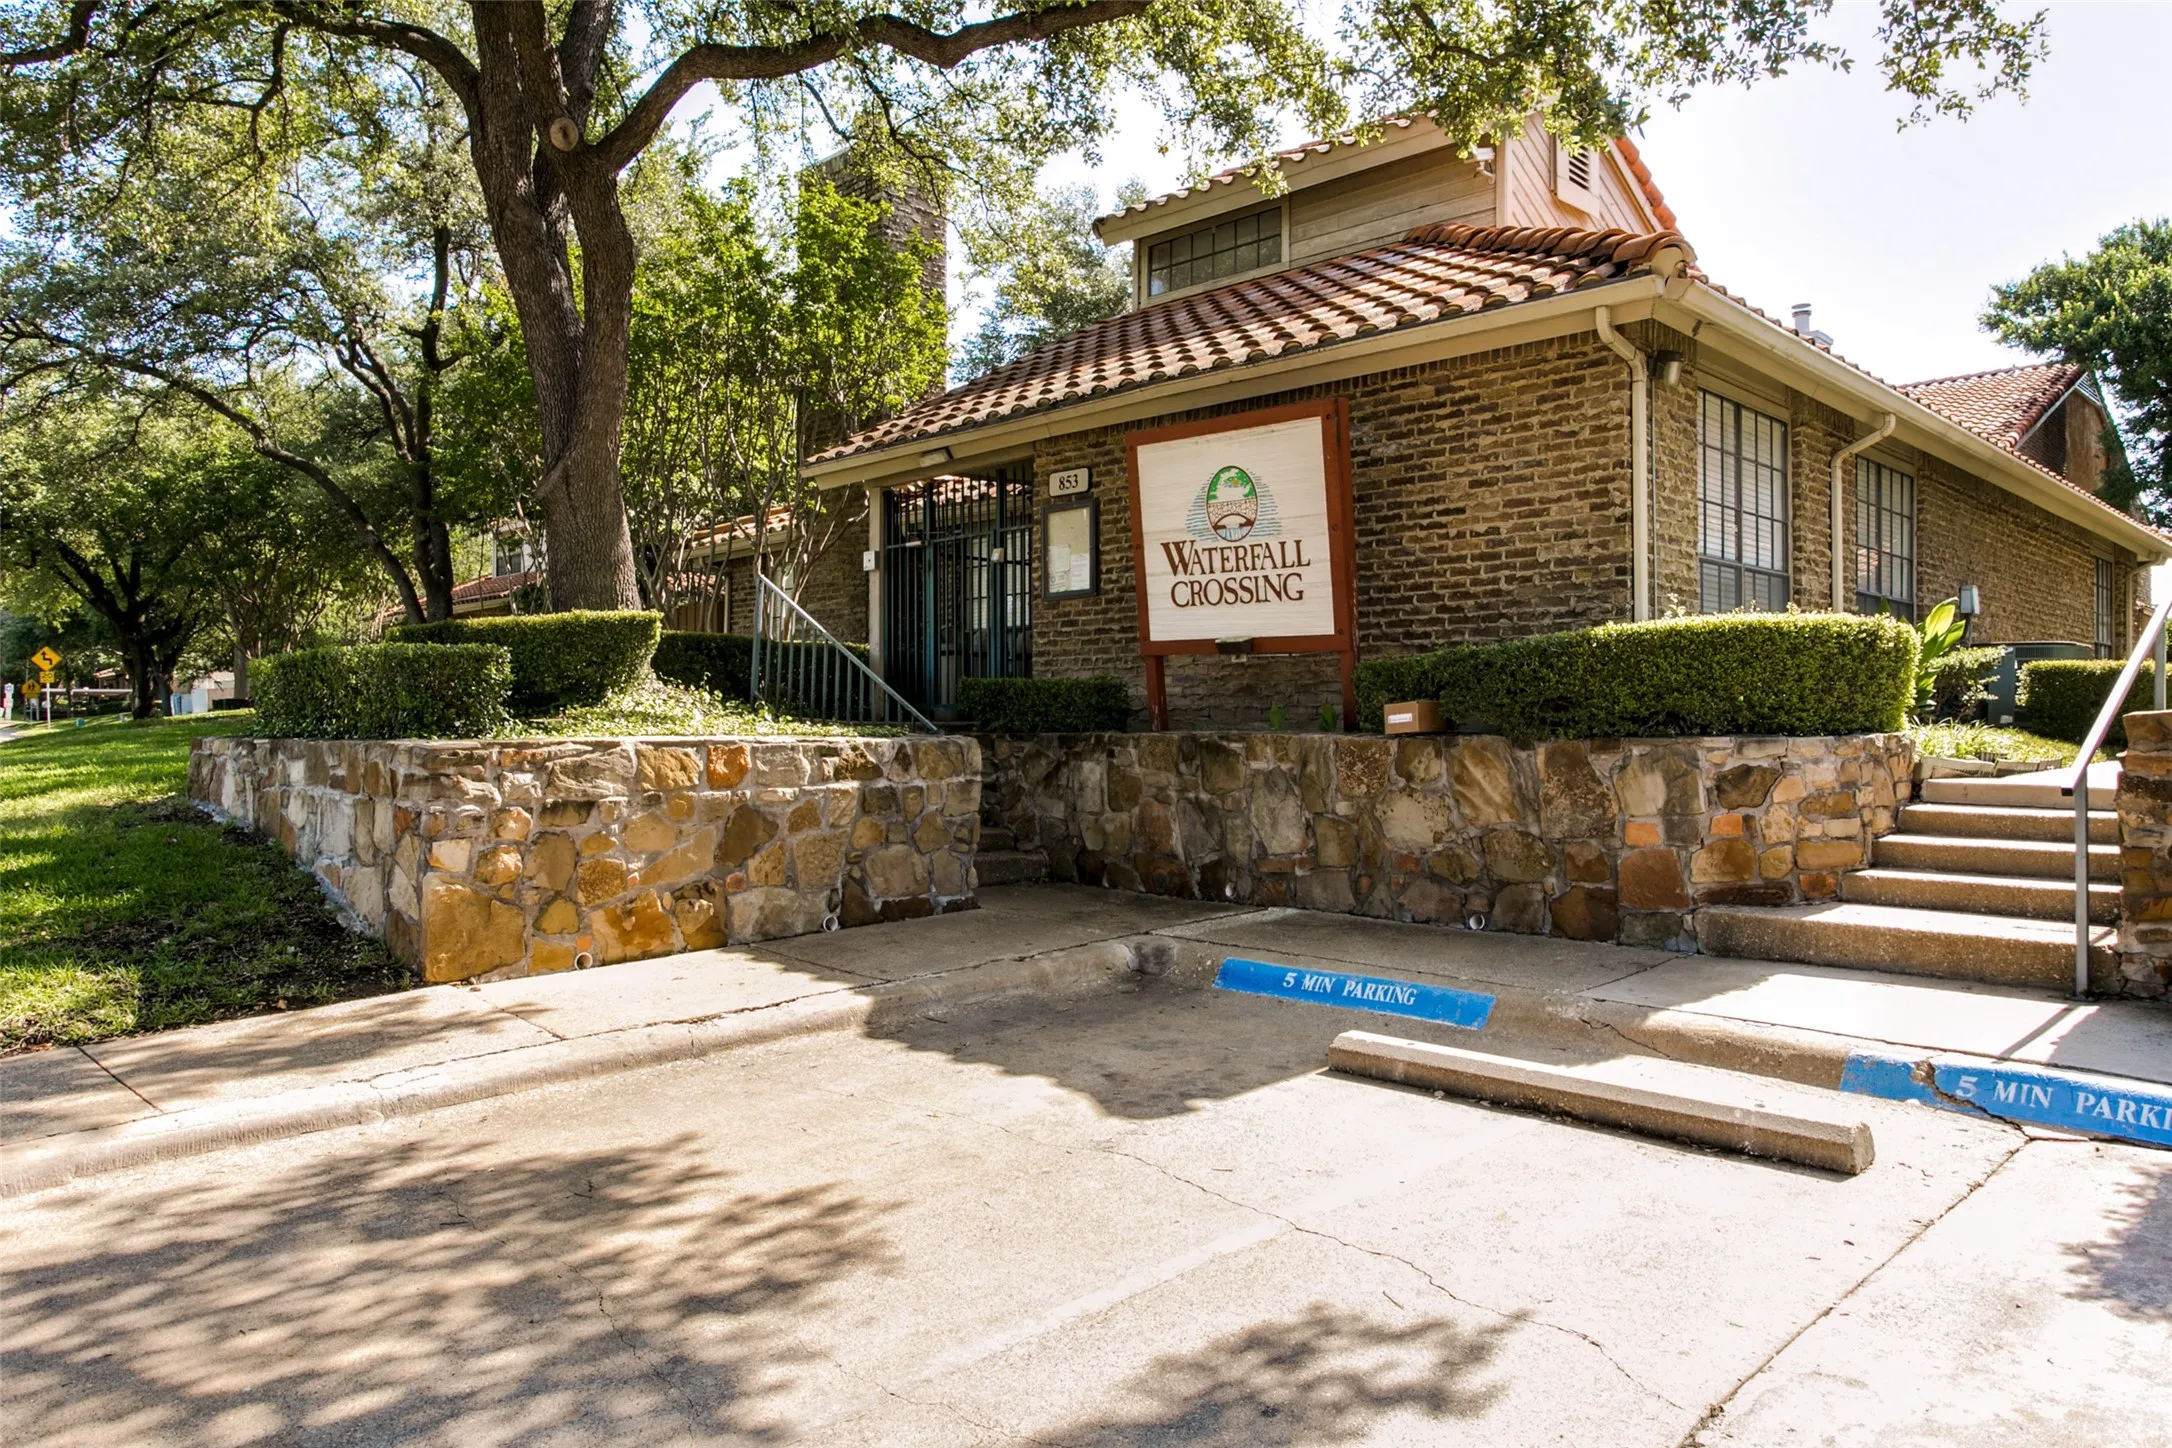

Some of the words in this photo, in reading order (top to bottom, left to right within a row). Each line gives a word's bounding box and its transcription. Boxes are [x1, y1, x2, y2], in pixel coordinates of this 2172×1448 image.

[1058, 474, 1079, 490] 853
[1160, 539, 1311, 577] WATERFALL
[1170, 572, 1304, 608] CROSSING
[1282, 972, 1298, 988] 5
[1301, 974, 1335, 993] MIN
[1342, 980, 1417, 1006] PARKING
[1955, 1075, 1979, 1098] 5
[1993, 1080, 2054, 1109] MIN
[2074, 1091, 2172, 1131] PARKI
